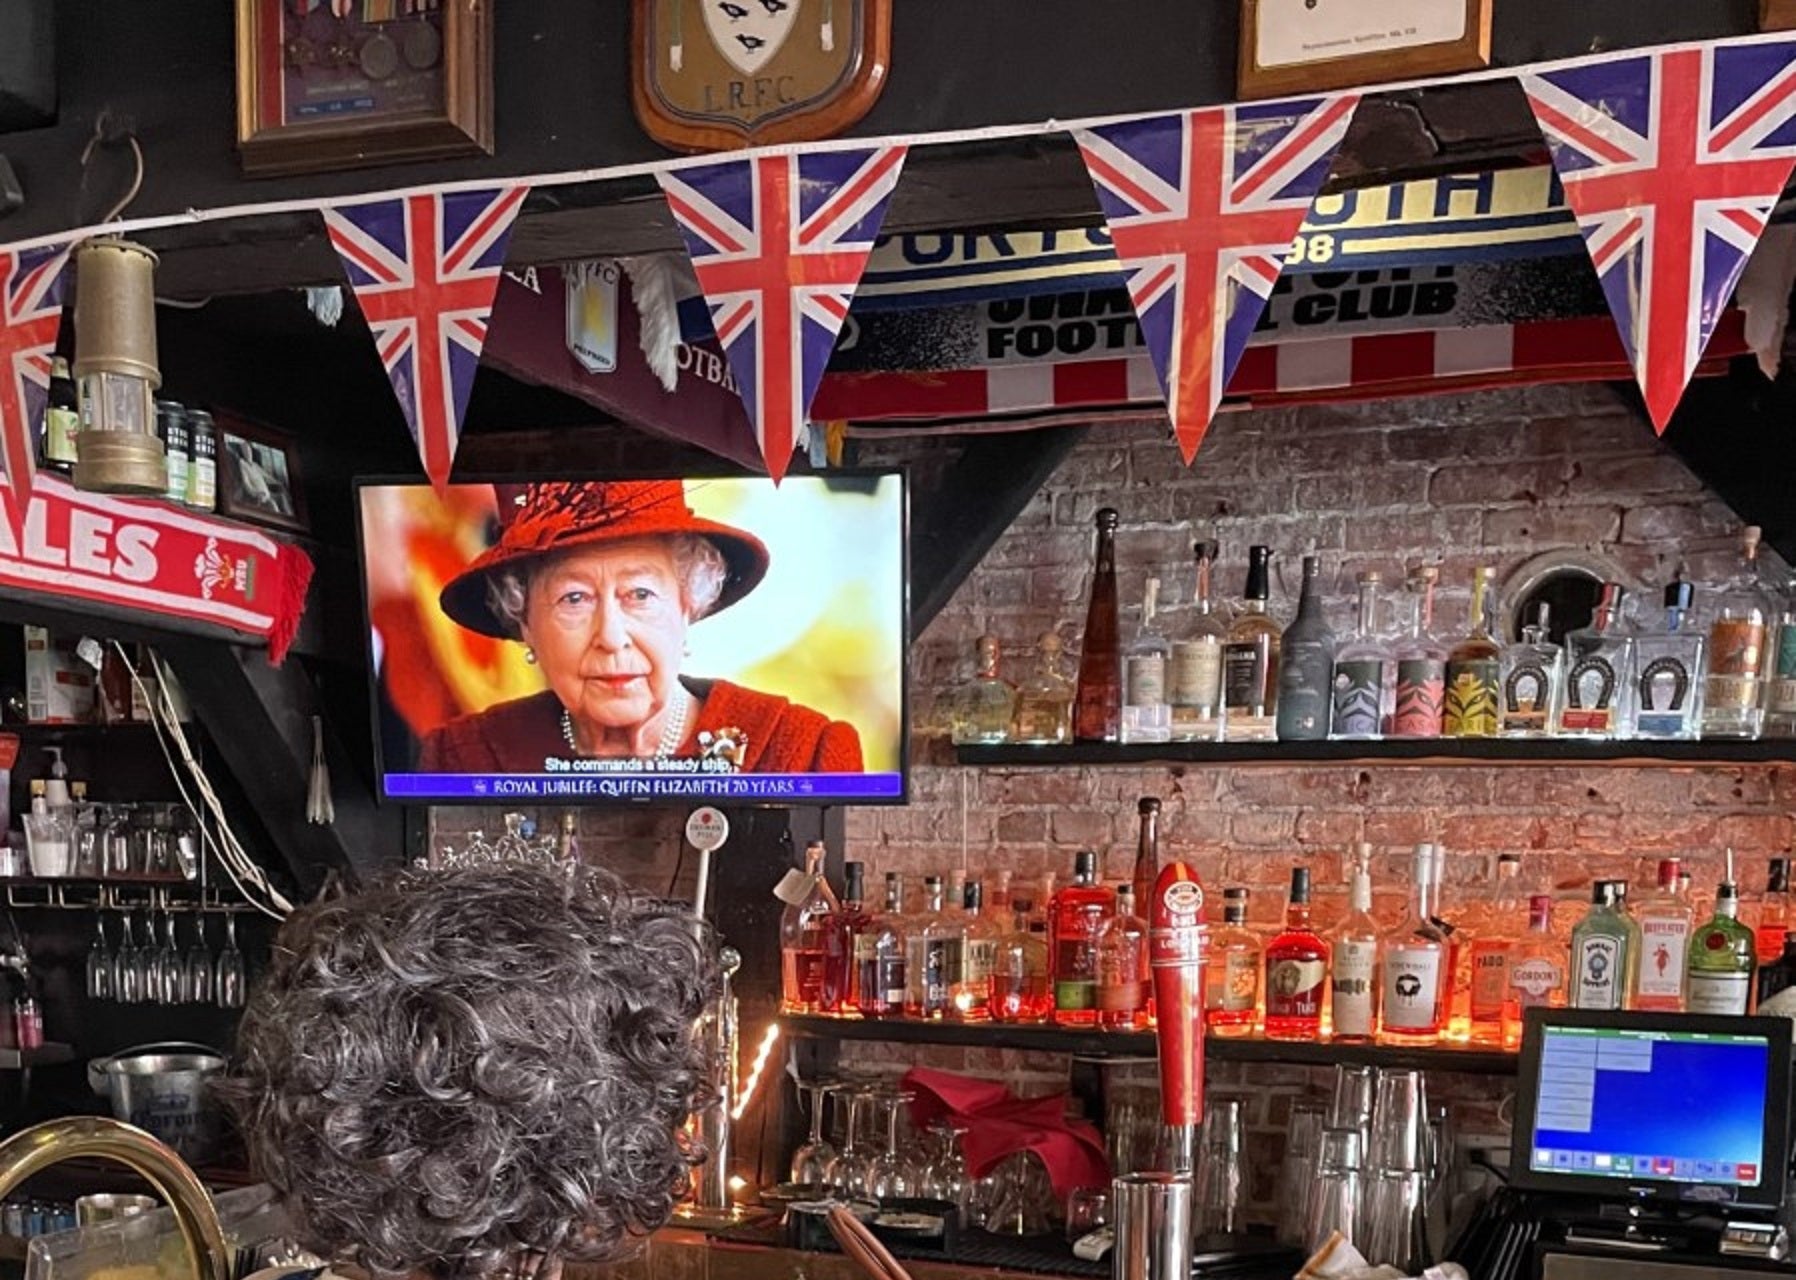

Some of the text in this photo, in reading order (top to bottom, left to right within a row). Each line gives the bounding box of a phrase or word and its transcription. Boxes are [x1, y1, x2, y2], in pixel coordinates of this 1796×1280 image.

[1293, 281, 1459, 325] CLUB
[545, 757, 571, 771] She
[572, 757, 643, 771] commands
[646, 761, 654, 771] a
[657, 757, 699, 773] steady
[494, 780, 539, 794] ROYAL
[600, 780, 651, 796] QUEEN
[654, 780, 730, 794] ELIZABETH
[733, 780, 749, 794] 70
[751, 780, 795, 793] YEARS
